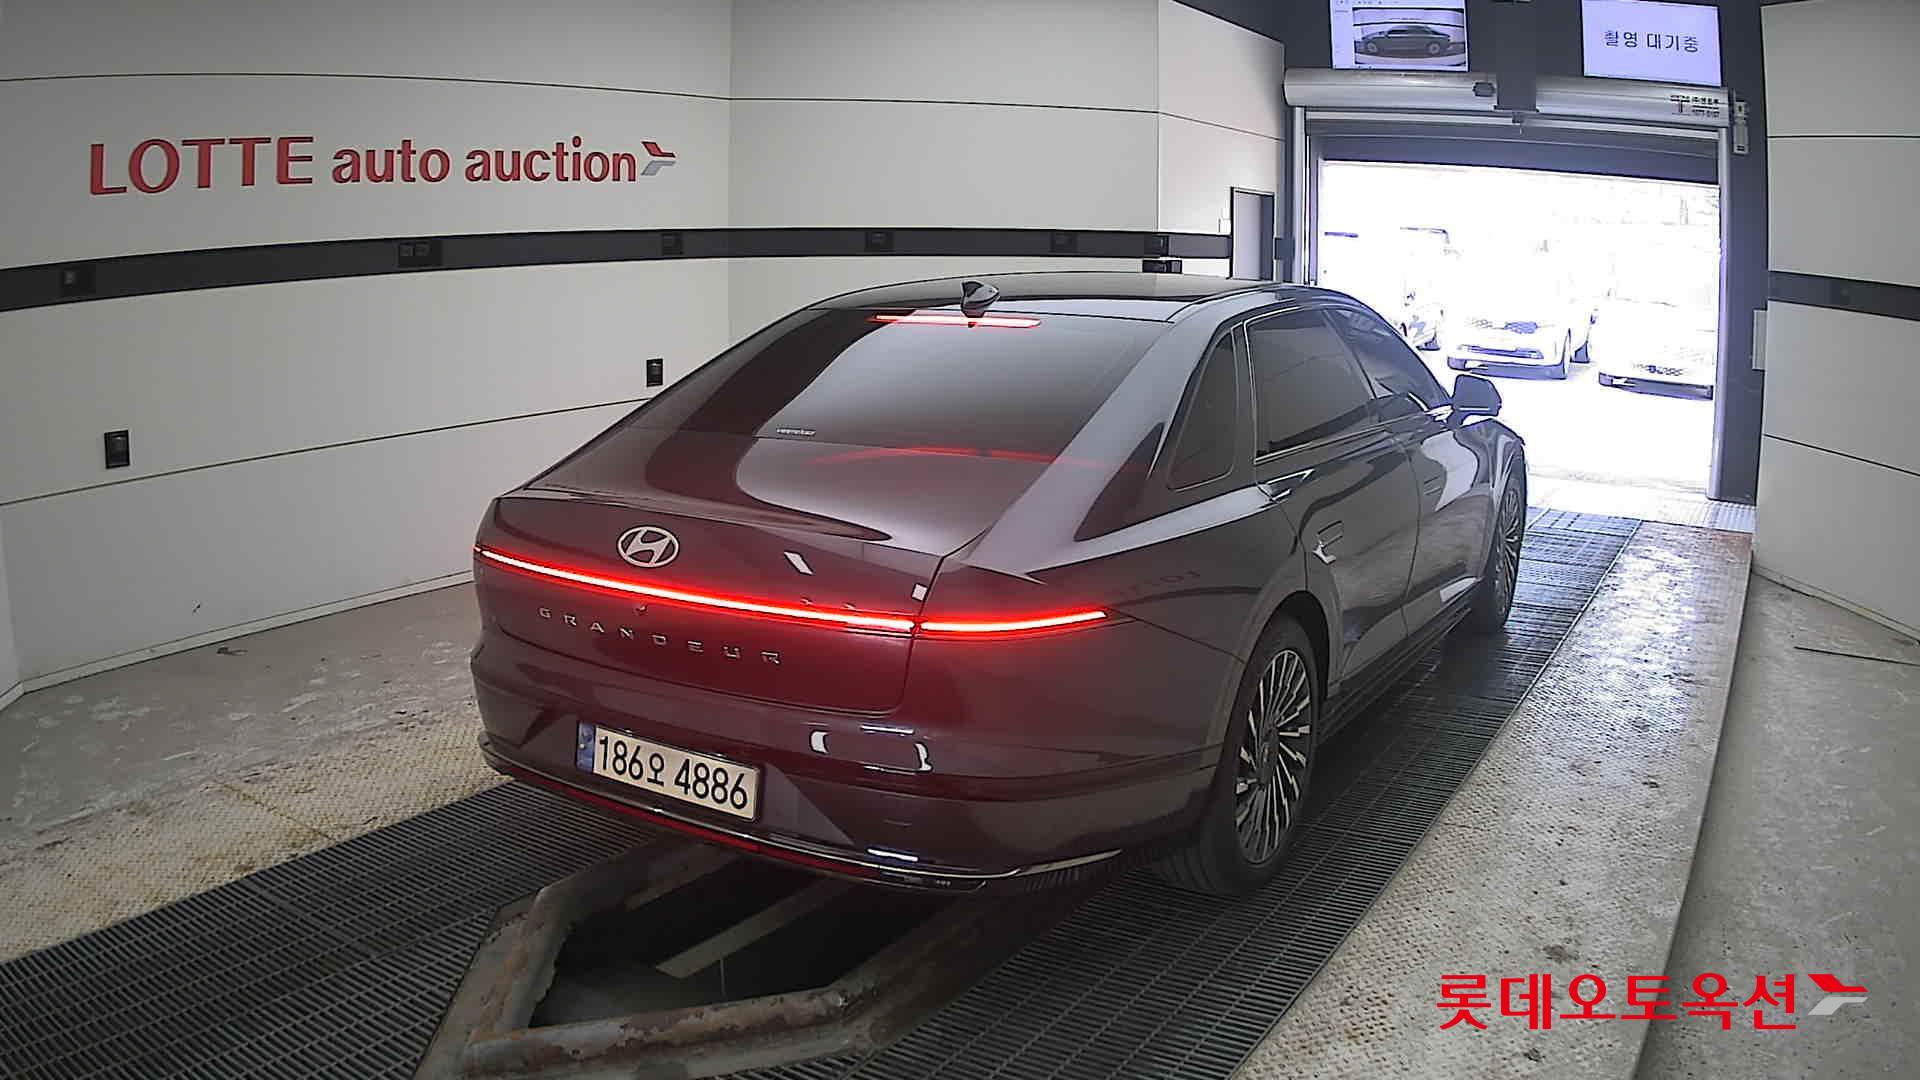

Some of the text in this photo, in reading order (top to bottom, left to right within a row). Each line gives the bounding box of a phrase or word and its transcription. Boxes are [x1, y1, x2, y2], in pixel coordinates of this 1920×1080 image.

[1604, 30, 1698, 52] 촬영 대기중
[90, 136, 637, 195] LOTTE auto auction
[537, 606, 782, 665] GRANDEUR
[599, 735, 748, 810] 186오 4886
